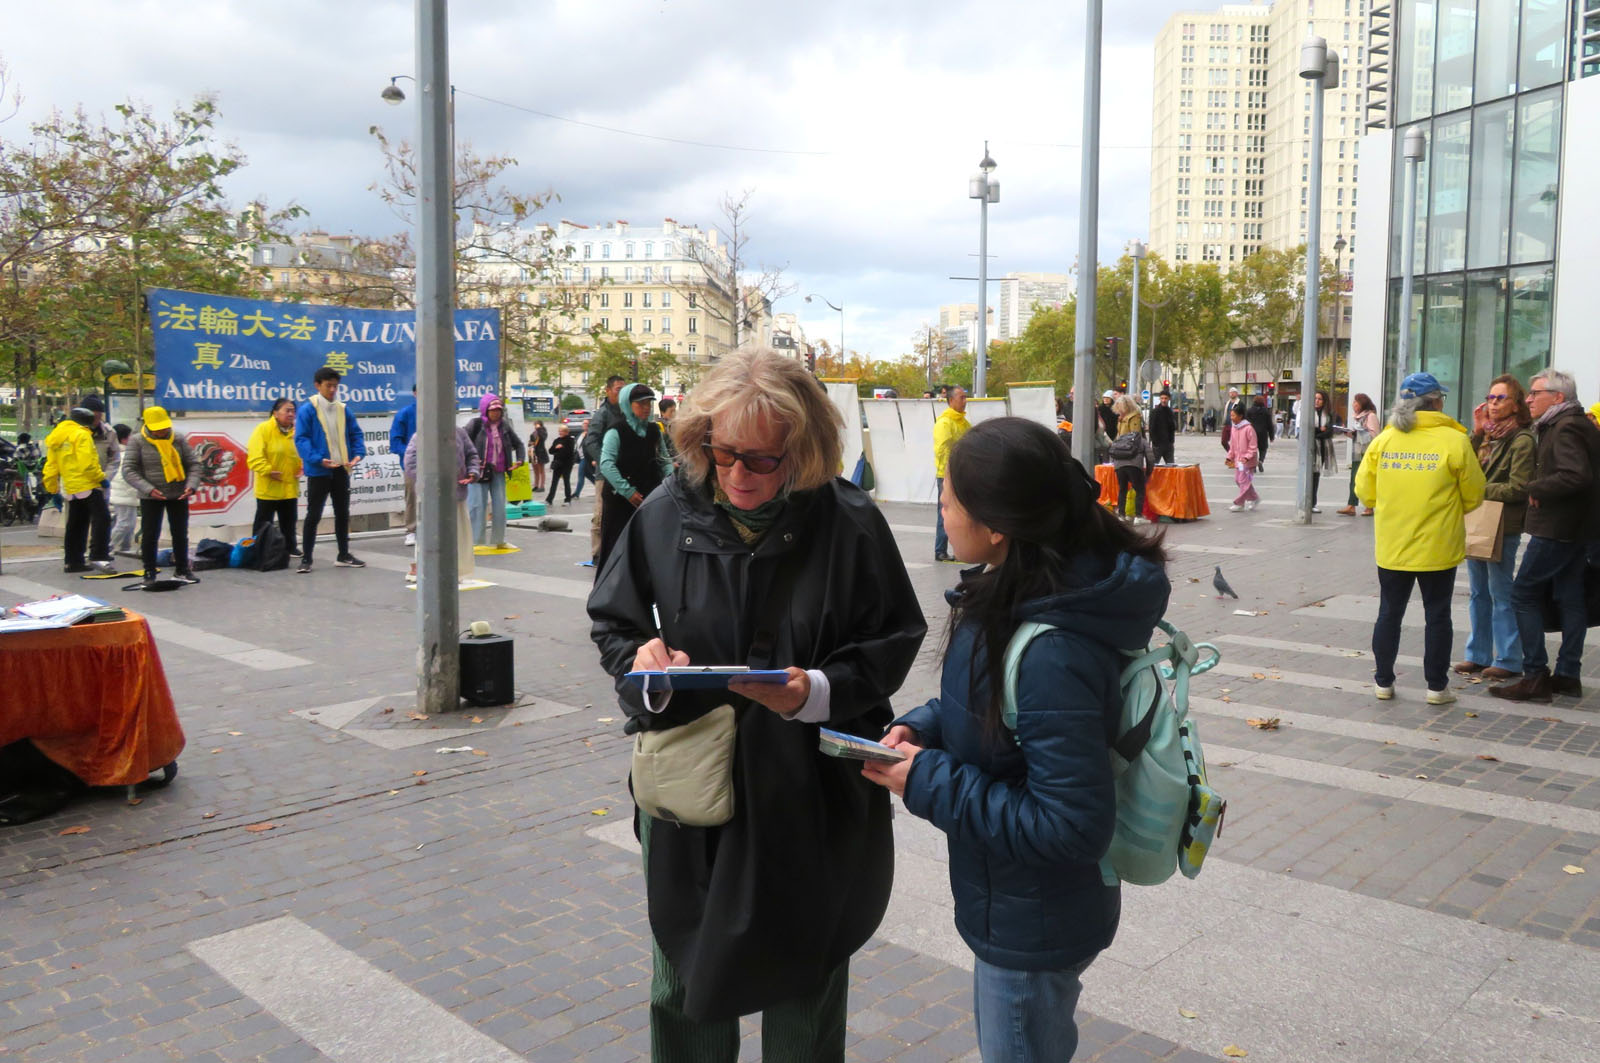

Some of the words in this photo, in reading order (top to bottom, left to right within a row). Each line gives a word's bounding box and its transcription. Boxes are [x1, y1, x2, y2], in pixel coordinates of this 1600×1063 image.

[158, 301, 317, 341] 法輪大法
[454, 320, 496, 341] AFA
[192, 342, 224, 370] 真
[229, 353, 271, 371] Zhen
[458, 358, 483, 372] Ren
[357, 361, 396, 375] Shan
[164, 377, 307, 401] Authenticité
[336, 382, 397, 402] Bonté
[1382, 451, 1398, 459] FALUN
[1400, 452, 1415, 460] DAFA
[1424, 453, 1439, 461] GOOD
